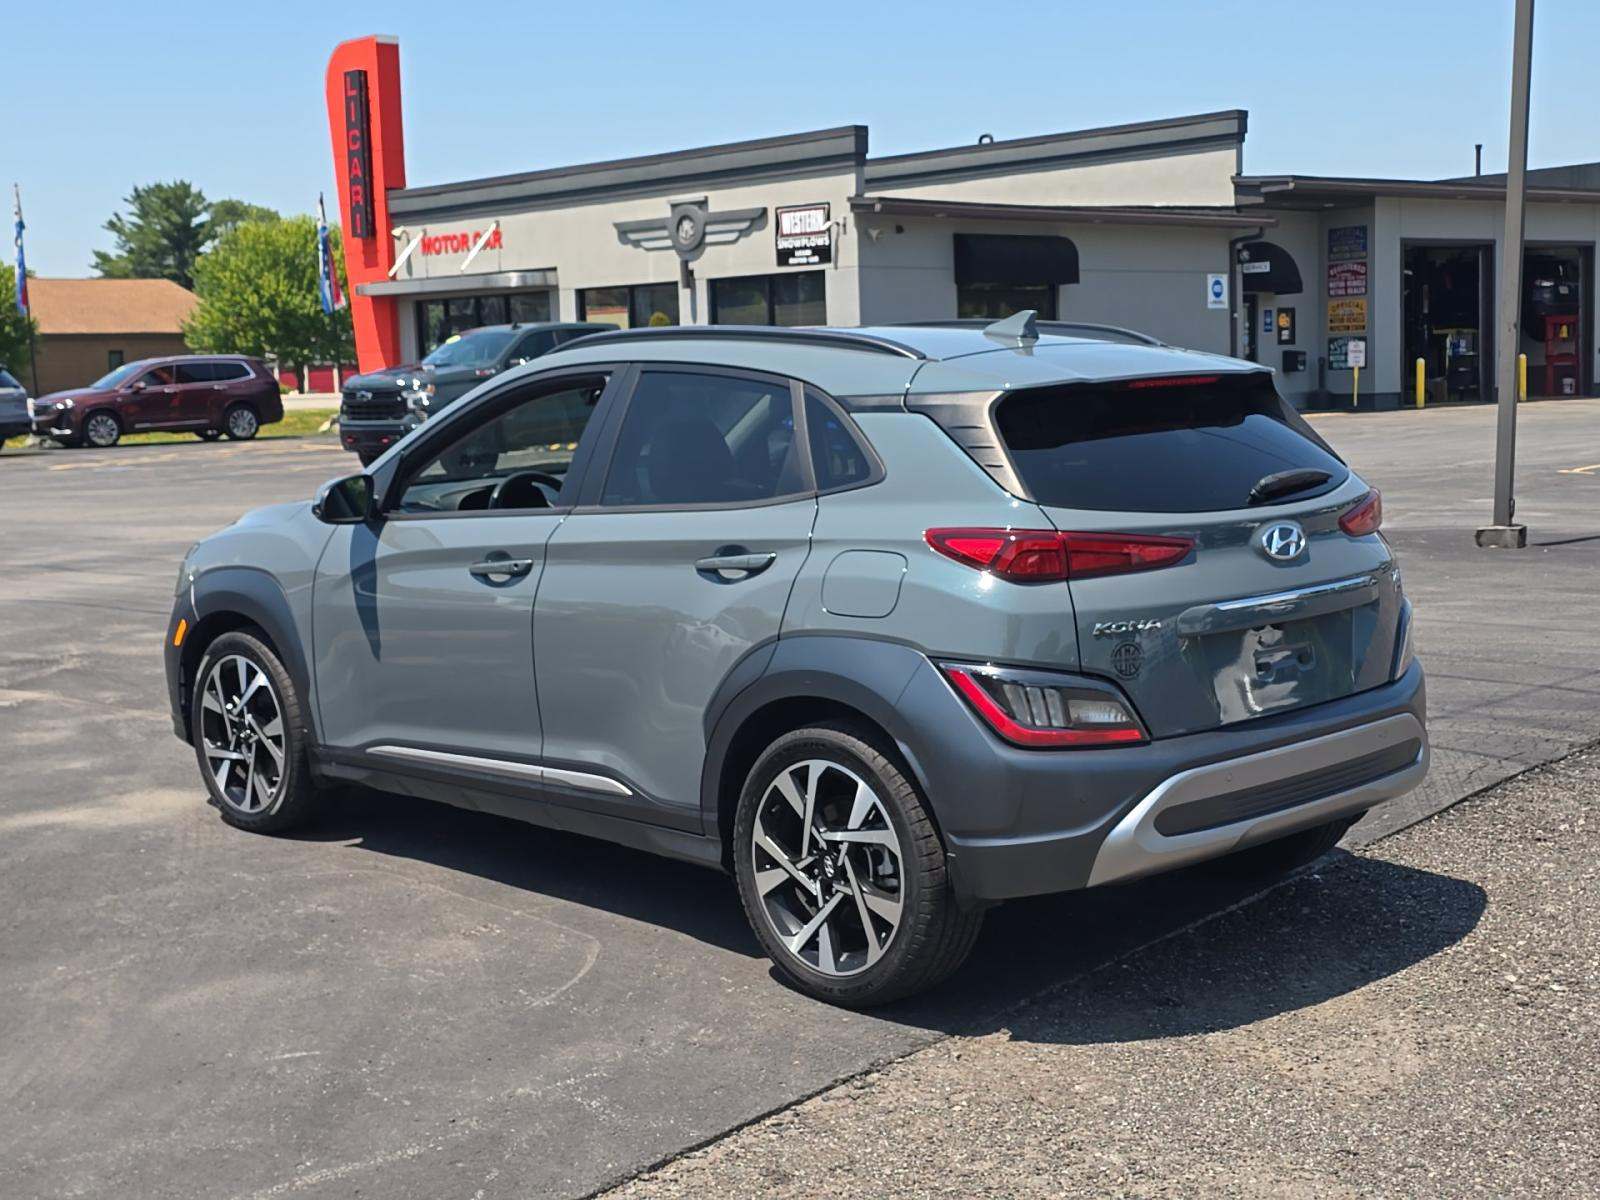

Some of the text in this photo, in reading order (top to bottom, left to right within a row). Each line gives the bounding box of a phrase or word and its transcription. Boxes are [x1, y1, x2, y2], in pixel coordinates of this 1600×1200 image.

[345, 75, 363, 234] LICARI
[781, 209, 825, 235] WESTERN
[421, 233, 470, 255] MOTOR
[1092, 620, 1162, 635] KONA
